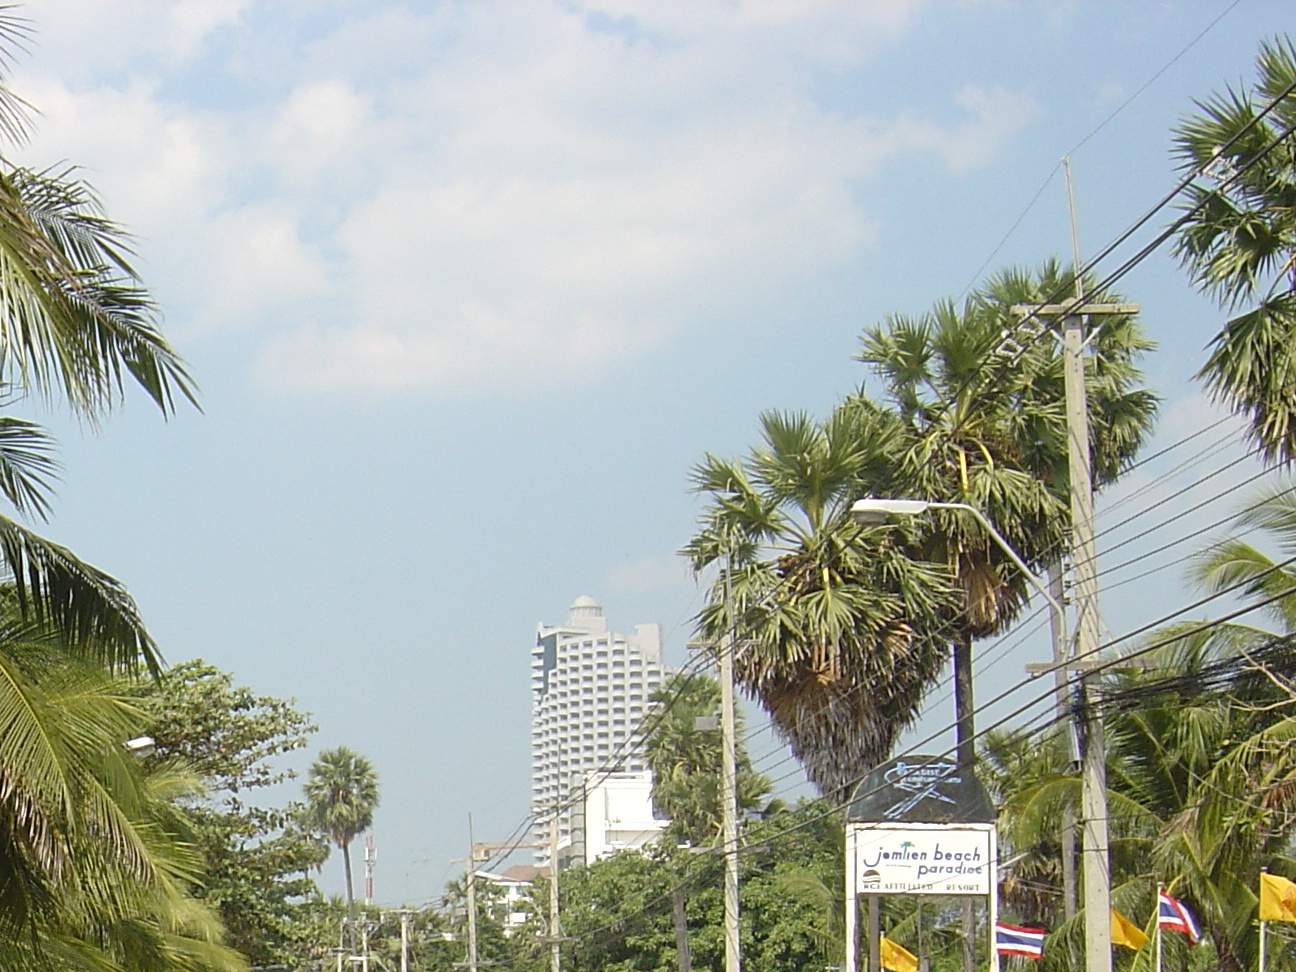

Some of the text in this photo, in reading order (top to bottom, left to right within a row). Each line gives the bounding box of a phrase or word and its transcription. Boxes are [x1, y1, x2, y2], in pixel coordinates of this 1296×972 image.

[862, 842, 981, 868] jomtien beach
[917, 861, 983, 880] paradise
